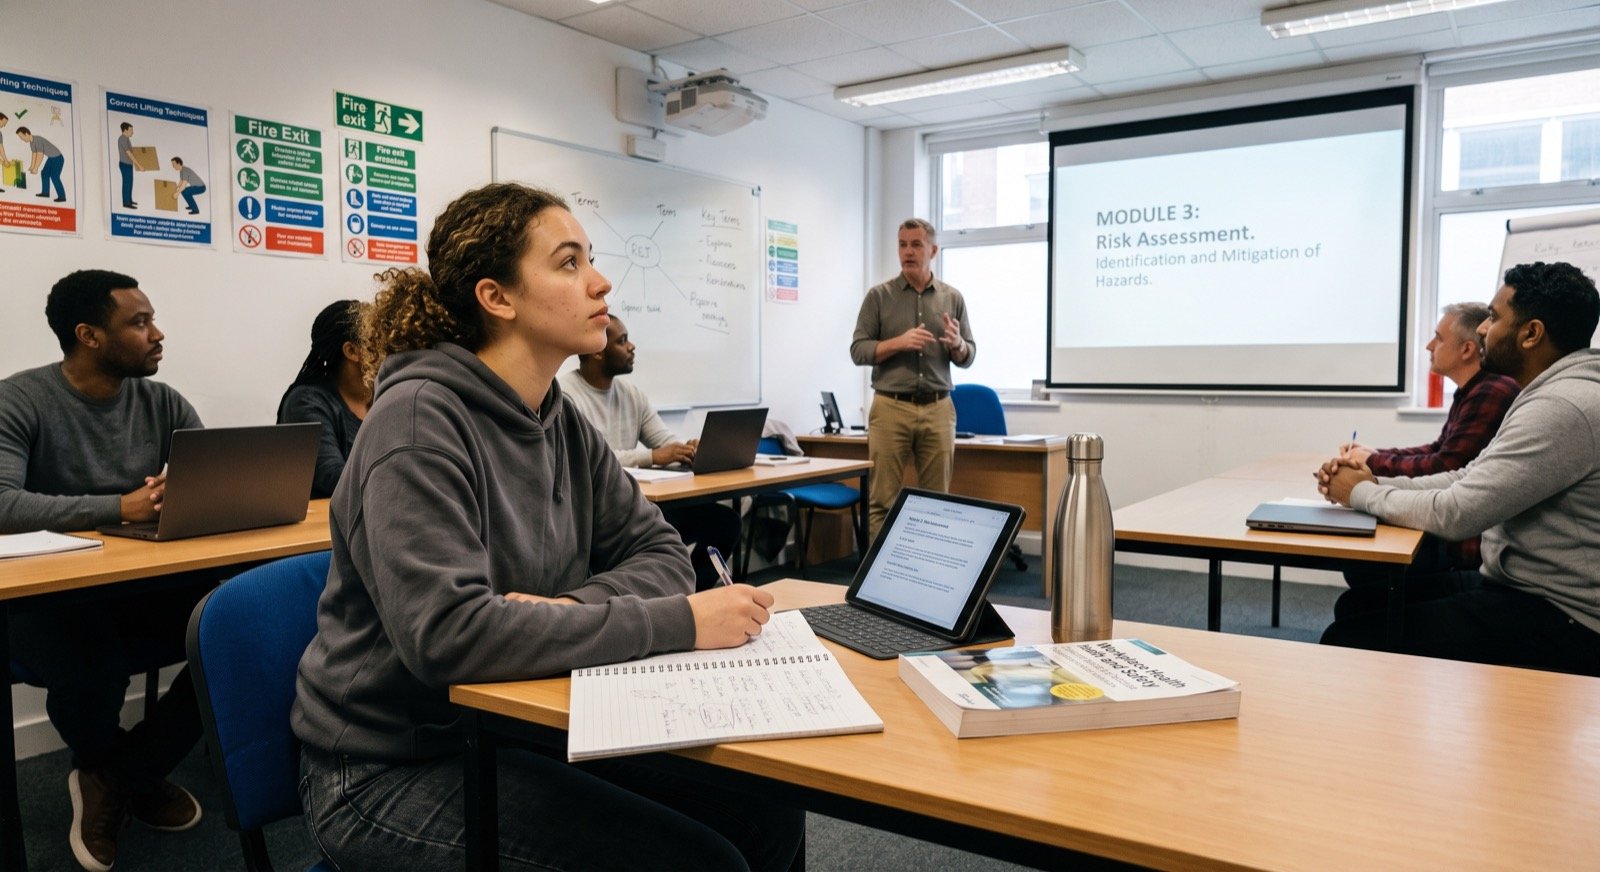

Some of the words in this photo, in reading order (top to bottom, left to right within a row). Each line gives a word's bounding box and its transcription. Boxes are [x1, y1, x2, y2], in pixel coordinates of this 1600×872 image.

[21, 81, 69, 97] Techniques
[109, 98, 138, 109] Correct
[342, 96, 367, 113] Fire
[342, 114, 367, 128] exit
[248, 120, 278, 138] Fire
[281, 126, 311, 144] Exit
[376, 145, 391, 156] Fire
[392, 148, 405, 158] exit
[1096, 205, 1177, 226] MODULE
[1182, 203, 1200, 220] 3:
[1096, 232, 1131, 250] Risk
[1137, 225, 1255, 247] Assessment.
[1096, 253, 1186, 270] Identification
[1190, 250, 1217, 264] and
[1222, 245, 1299, 264] Mitigation
[1304, 243, 1322, 258] of
[1096, 273, 1153, 288] Hazards.
[1097, 642, 1149, 670] Workplace
[1146, 669, 1187, 688] Health
[1100, 658, 1129, 670] and
[1121, 669, 1160, 688] Safety
